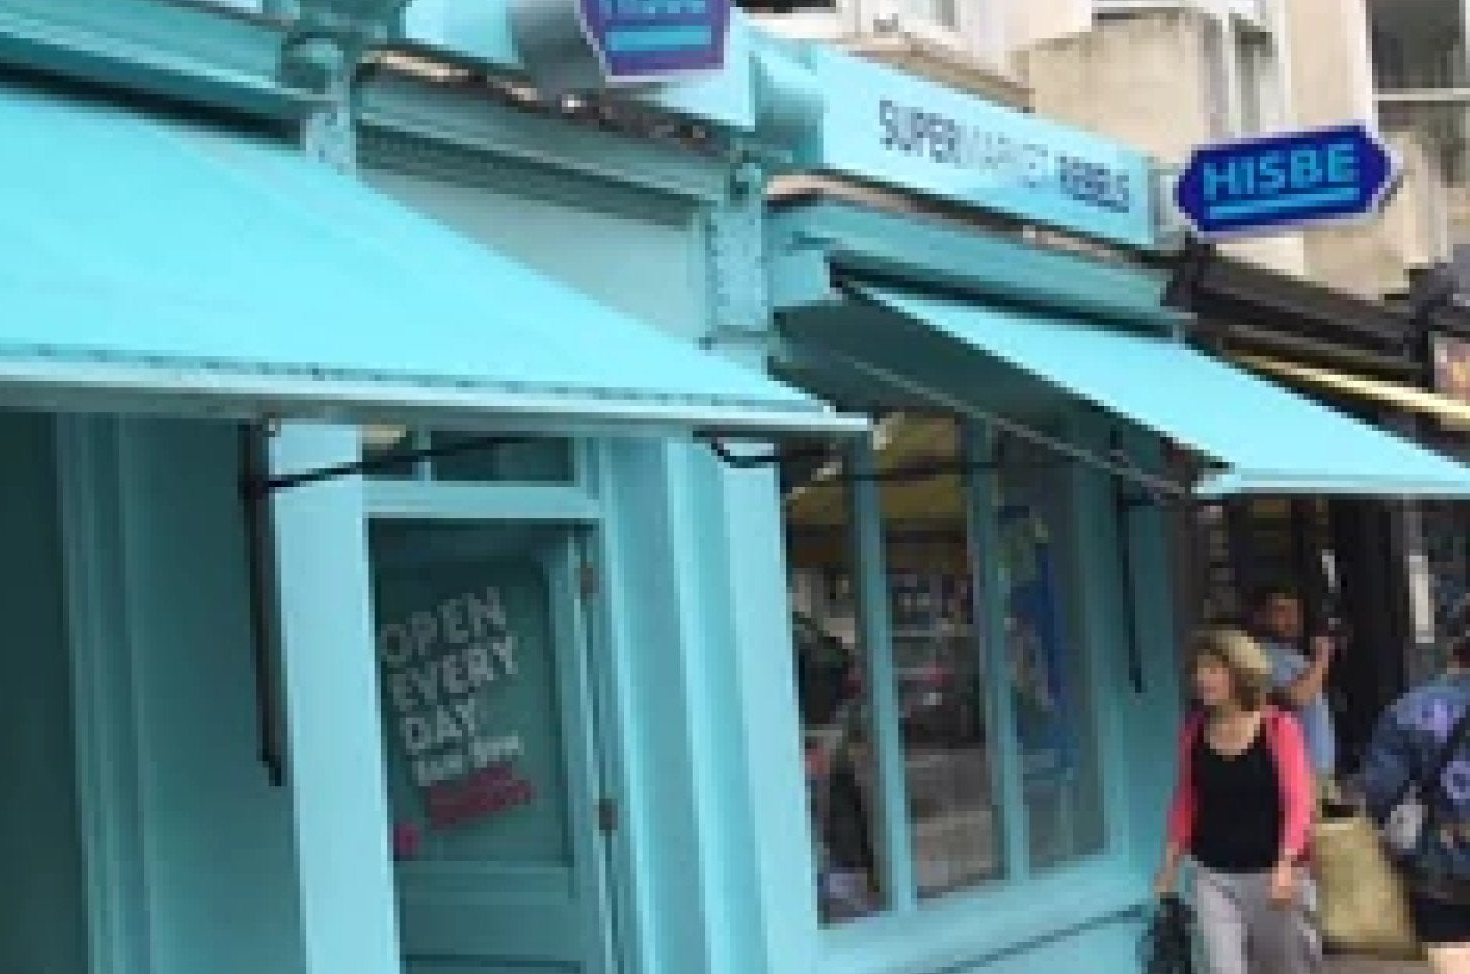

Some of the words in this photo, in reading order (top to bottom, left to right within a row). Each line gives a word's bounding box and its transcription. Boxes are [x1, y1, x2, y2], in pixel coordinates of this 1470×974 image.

[1204, 142, 1356, 201] HISBE
[382, 586, 507, 662] OPEN
[391, 635, 517, 707] EVERY
[401, 698, 475, 755] DAY
